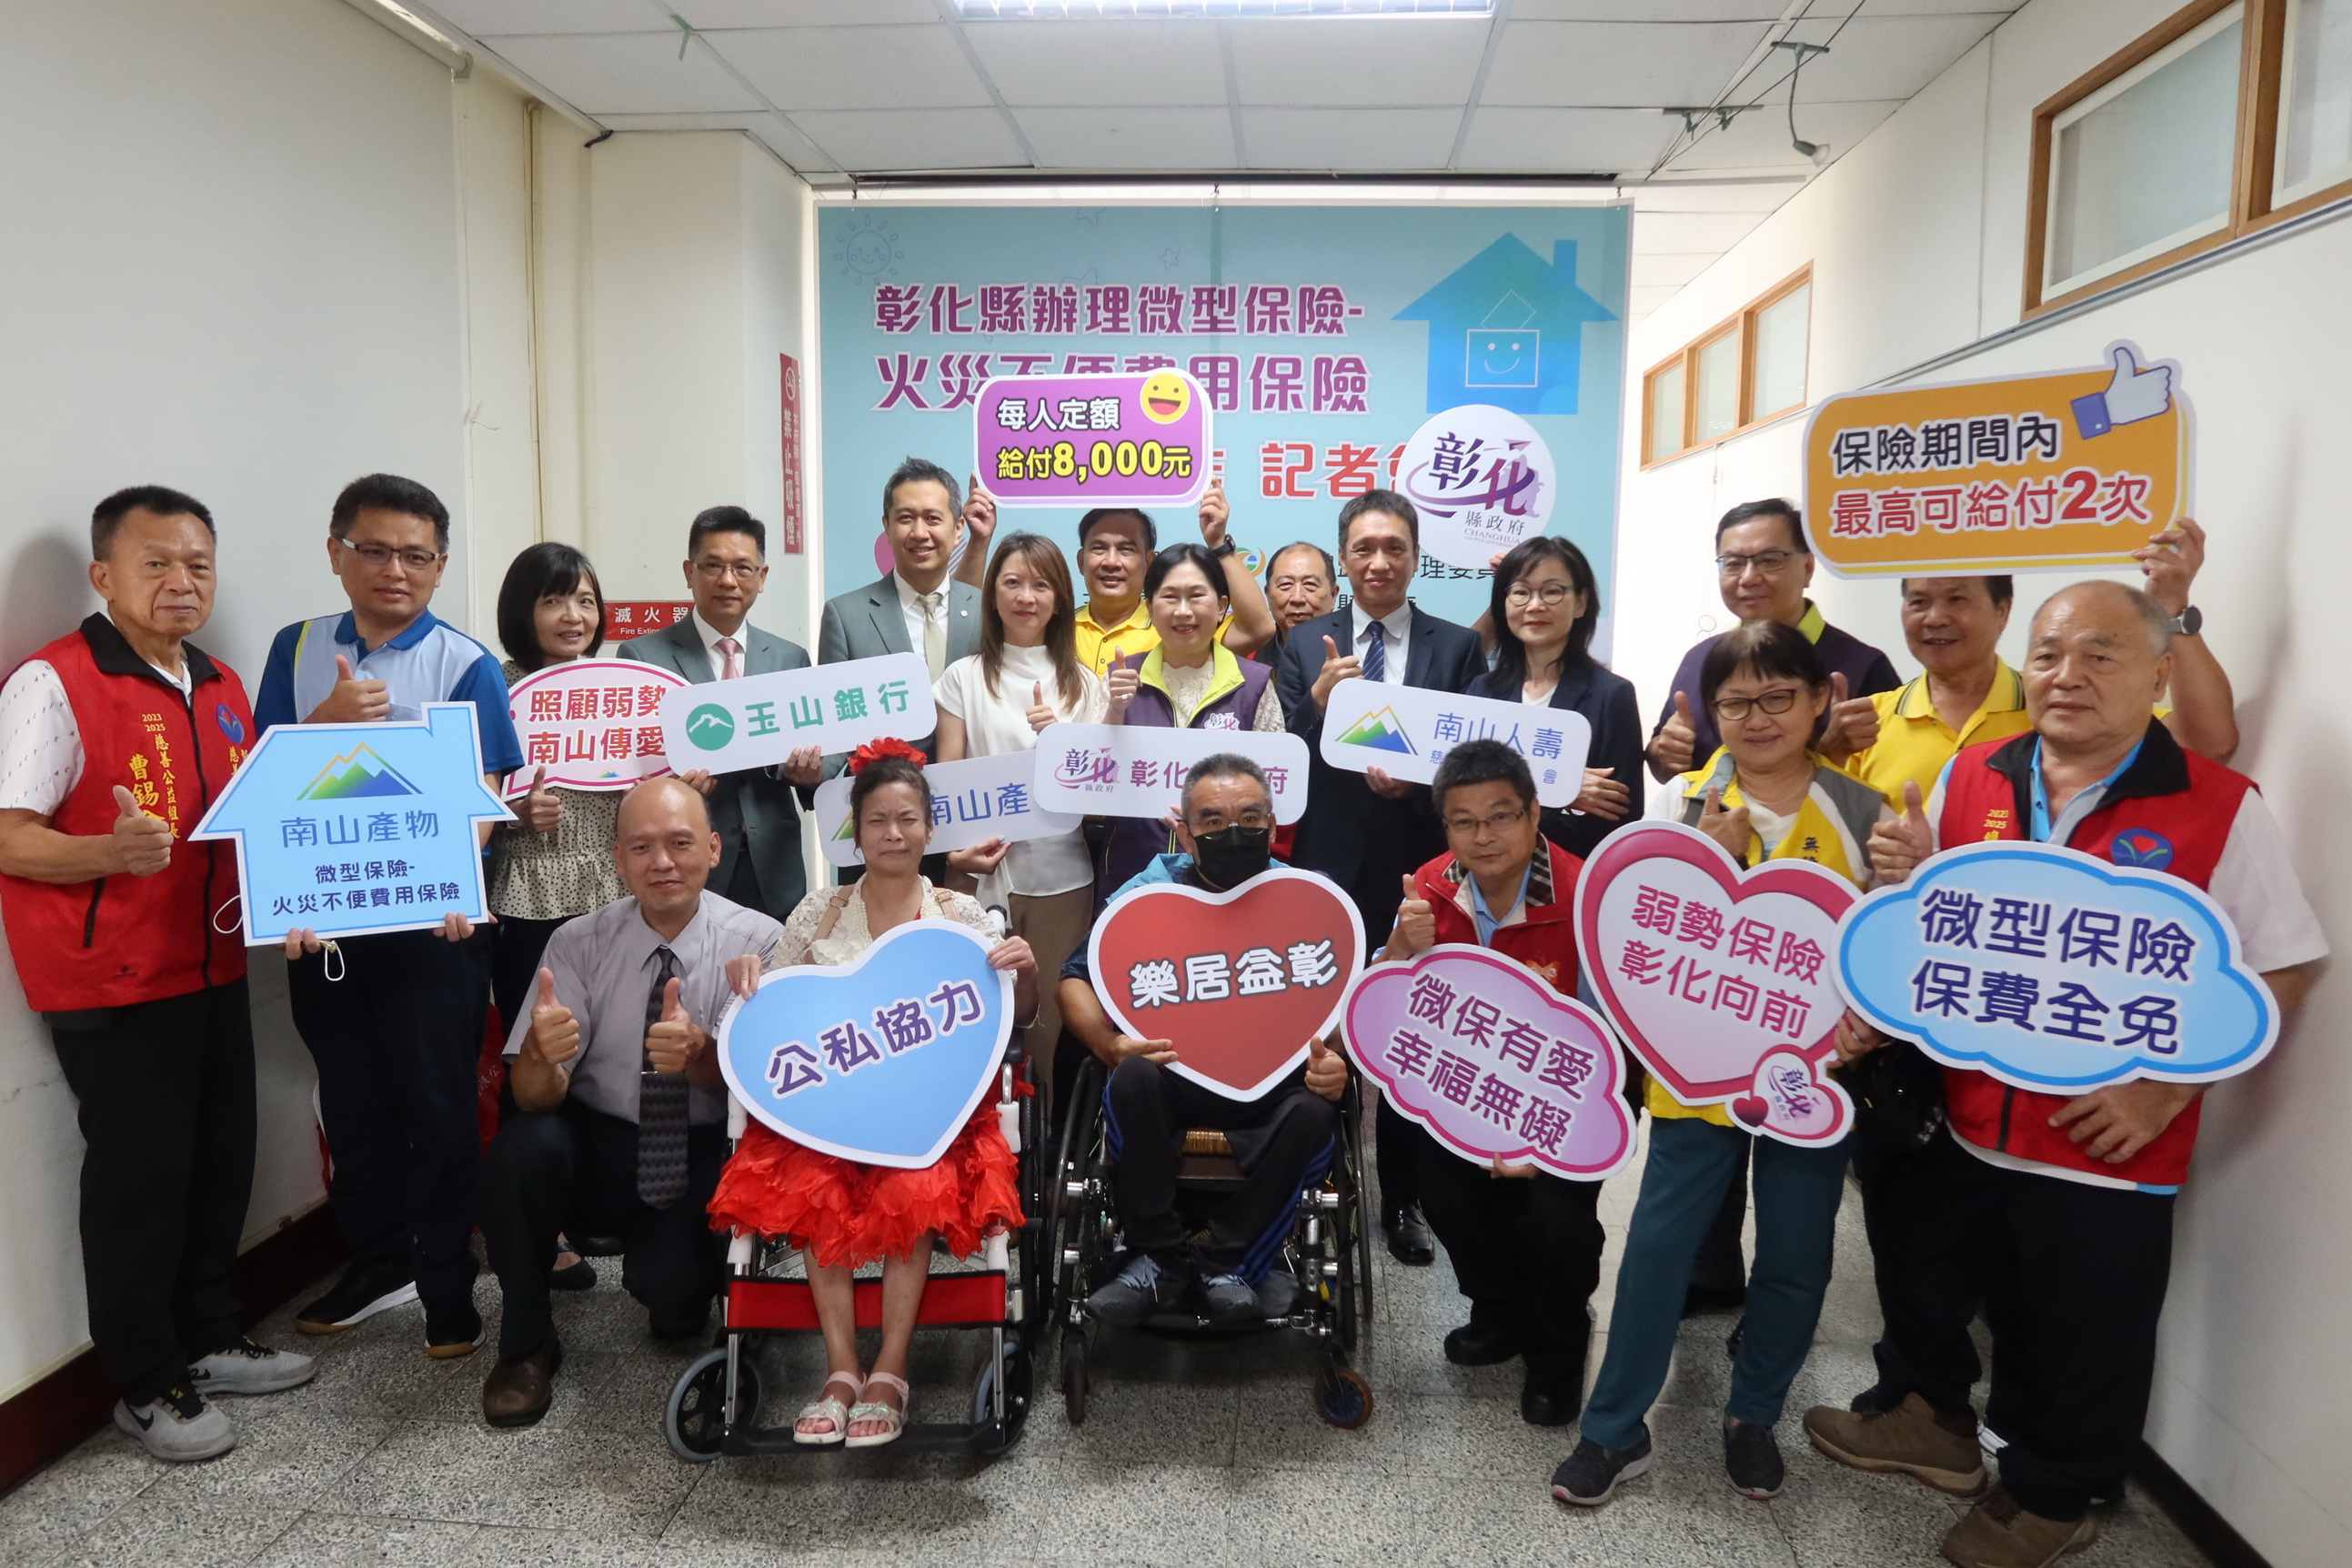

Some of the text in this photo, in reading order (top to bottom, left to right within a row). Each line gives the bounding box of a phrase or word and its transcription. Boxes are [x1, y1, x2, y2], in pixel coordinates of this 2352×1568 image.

[873, 284, 1365, 336] 彰化縣辦理微型保險-
[876, 353, 1370, 412] 火災用保險
[997, 398, 1121, 431] 每人定額
[997, 440, 1191, 482] 給付8,000元
[1832, 417, 2057, 475] 保險期間內
[1428, 431, 1528, 517] 彰化
[1464, 510, 1525, 536] 縣政府
[1832, 471, 2148, 535] 最高可給付2次
[1463, 528, 1521, 545] CHANGHUA
[615, 607, 689, 623] 滅火器
[141, 713, 163, 722] 2023
[528, 685, 667, 722] 照顧弱勢
[745, 679, 910, 738] 玉山銀行
[145, 723, 166, 732] 2025
[528, 726, 666, 766] 南山傳愛
[1433, 712, 1563, 759] 南山人壽
[1131, 759, 1289, 795] 彰化府
[280, 809, 440, 848] 南山產物
[1983, 819, 2007, 829] 2025
[315, 859, 416, 884] 微型保險-
[272, 881, 460, 915] 火災不便費用保險
[1631, 884, 1826, 987] 弱勢保險
[1920, 889, 2196, 982] 微型保險
[1129, 940, 1339, 1009] 樂居益彰
[1618, 940, 1813, 1039] 彰化向前
[1911, 960, 2179, 1055] 保費全免
[769, 981, 982, 1096] 公私協力
[1408, 972, 1597, 1101] 微保有愛
[1385, 1031, 1573, 1157] 幸福無礙
